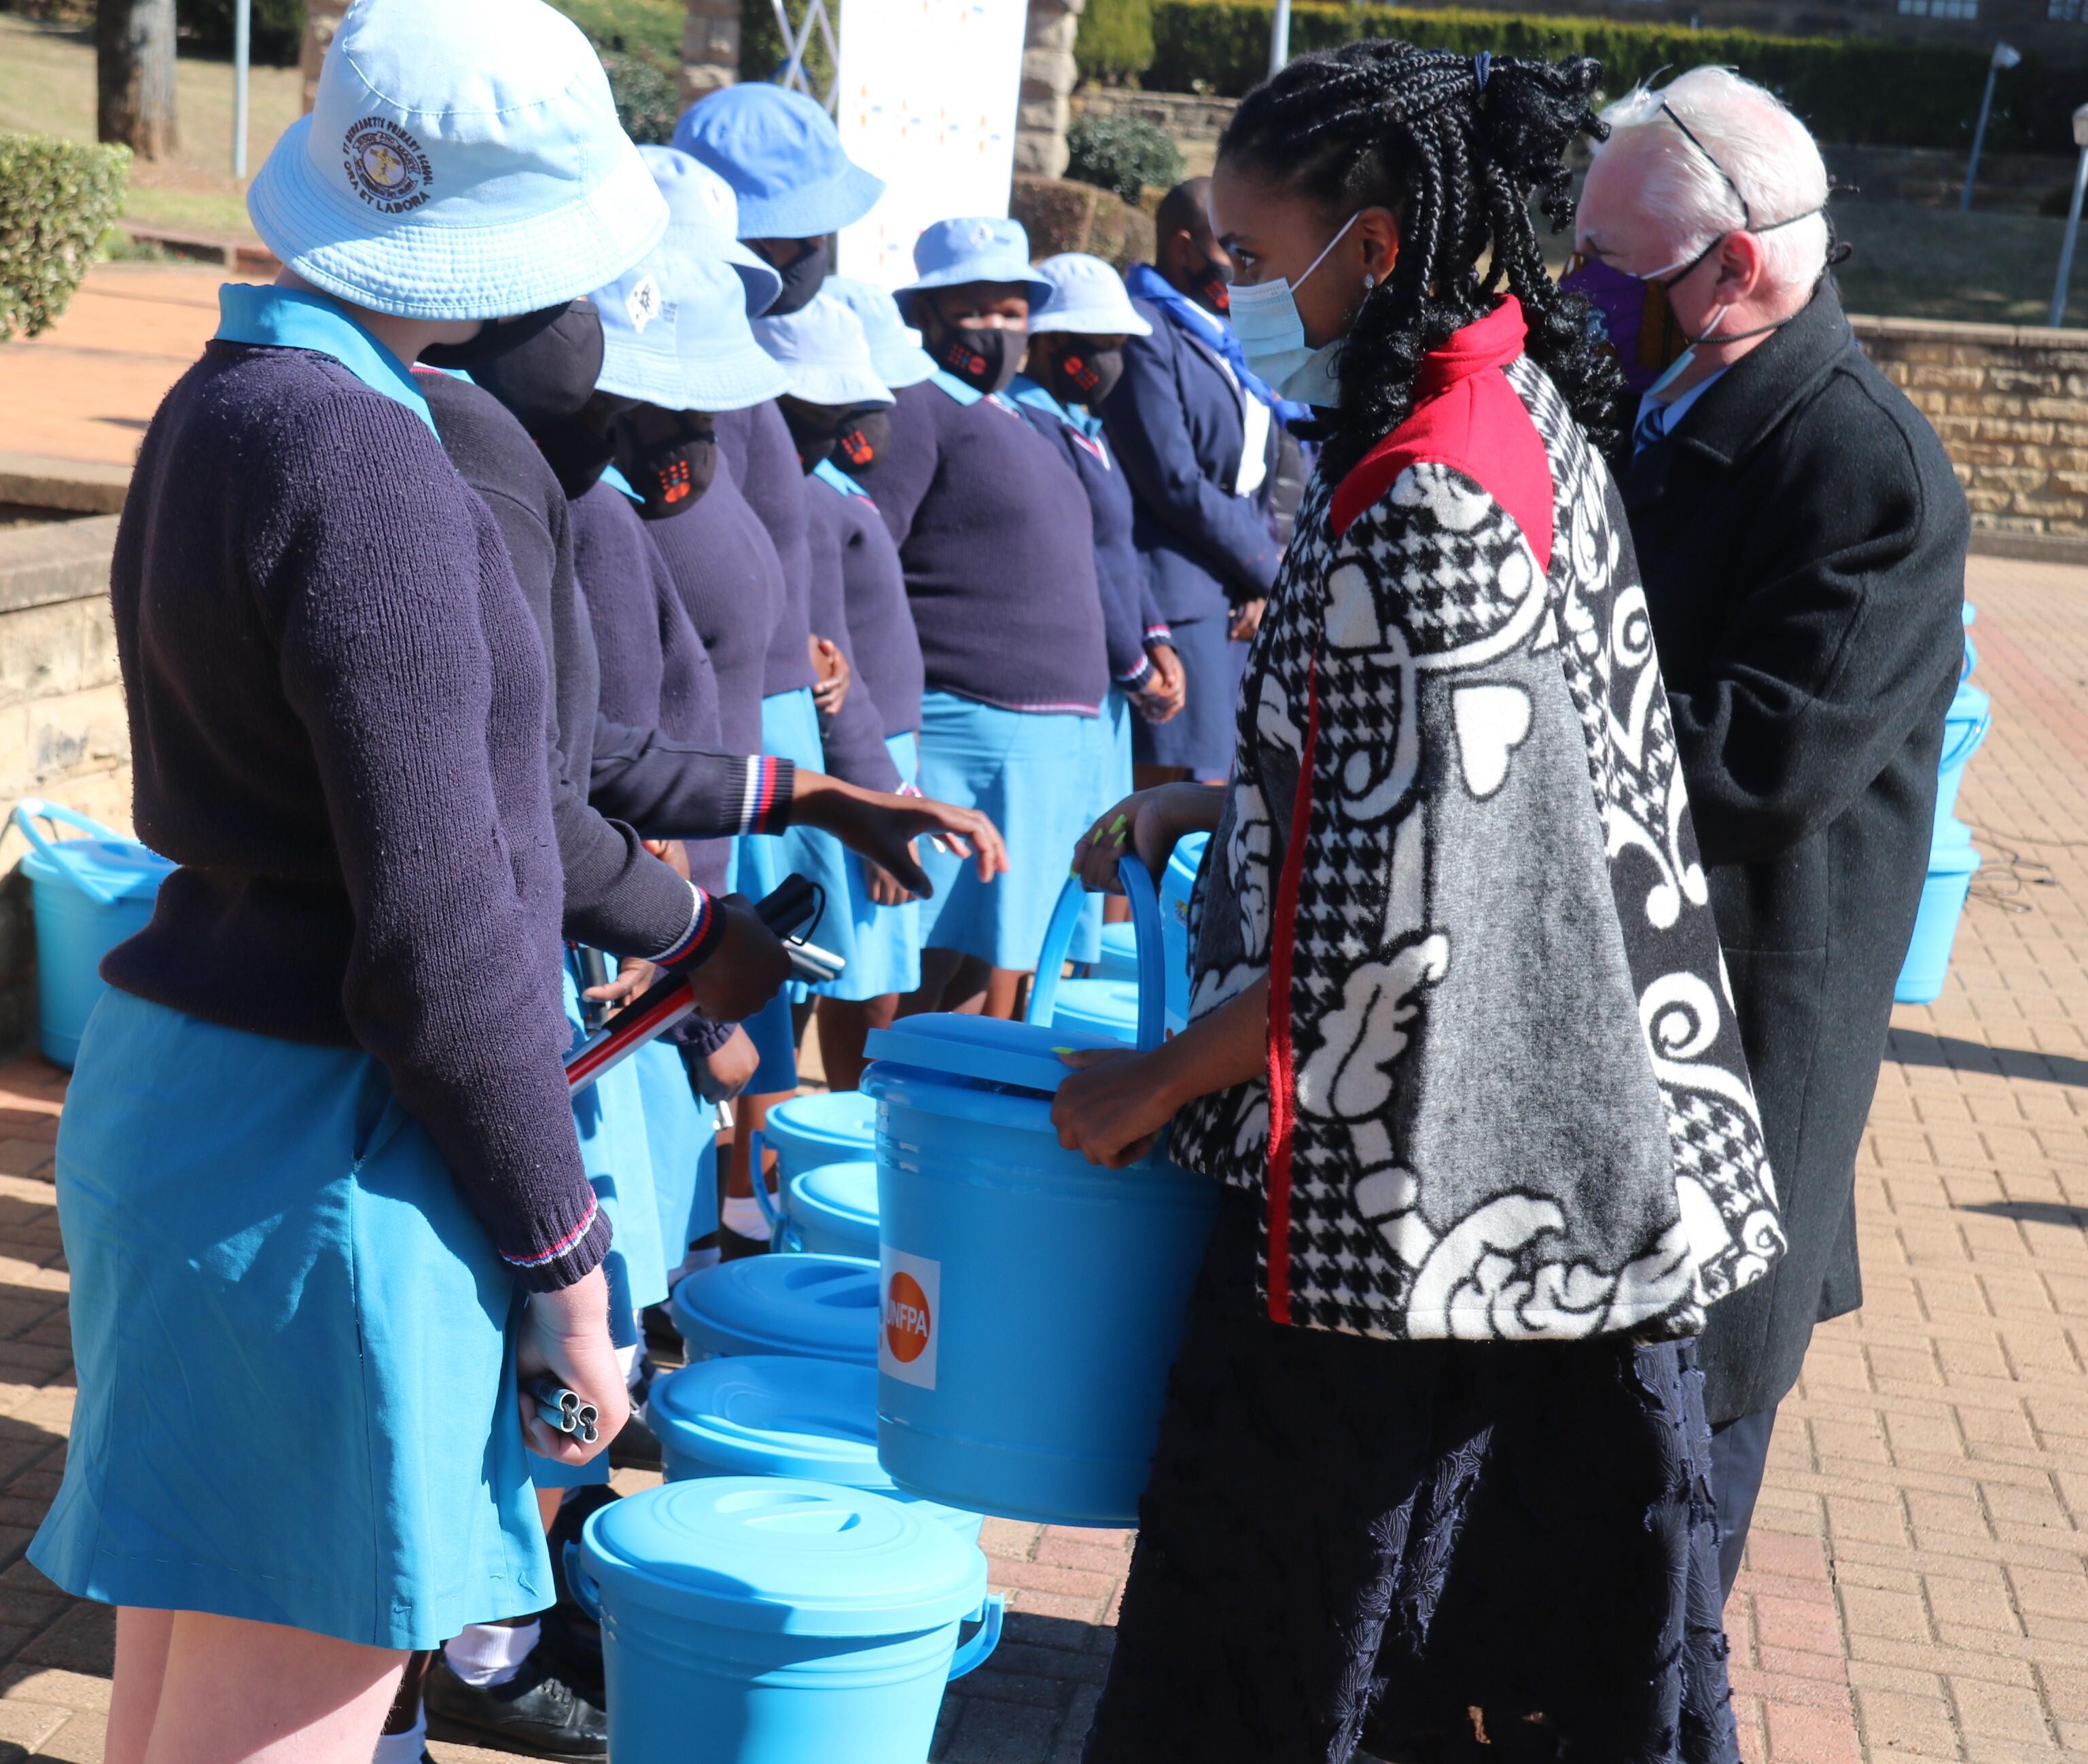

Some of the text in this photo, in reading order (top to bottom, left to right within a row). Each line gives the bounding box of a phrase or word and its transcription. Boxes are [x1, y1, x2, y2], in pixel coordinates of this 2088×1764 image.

[387, 121, 421, 152] PRIMARY
[417, 154, 433, 186] SCHOOL
[397, 145, 418, 172] MARY
[344, 161, 359, 190] ORA
[359, 190, 374, 205] ET
[376, 192, 431, 213] LABORA
